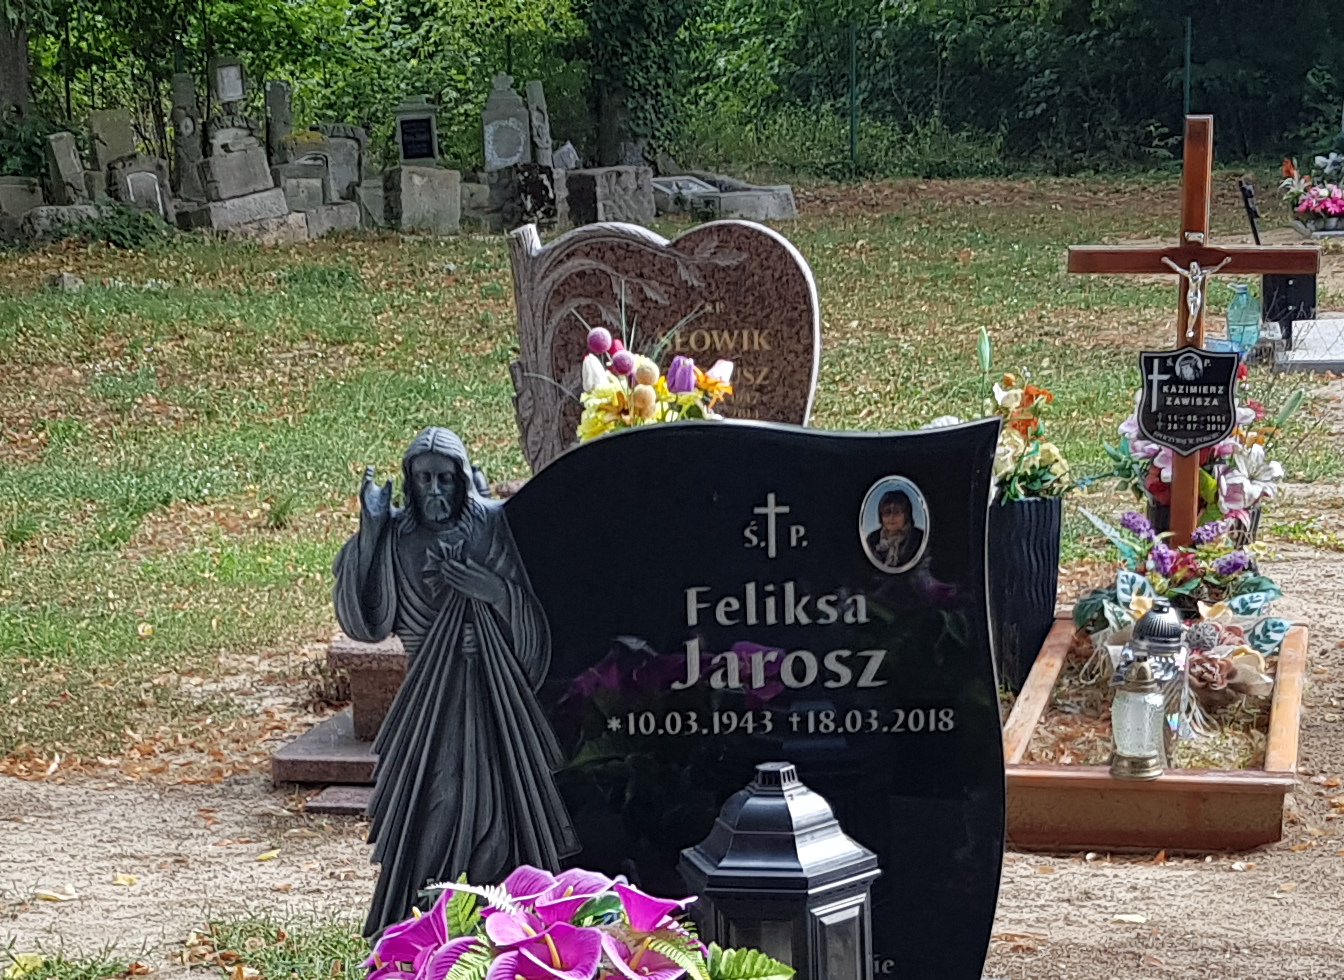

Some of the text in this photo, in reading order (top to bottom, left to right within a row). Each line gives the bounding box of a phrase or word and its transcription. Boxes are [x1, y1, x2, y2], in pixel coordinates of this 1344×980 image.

[1161, 384, 1225, 395] KAZIMIERZ
[1165, 396, 1219, 406] ZAWISZA
[683, 580, 872, 627] Feliksa
[669, 635, 889, 691] Jarosz
